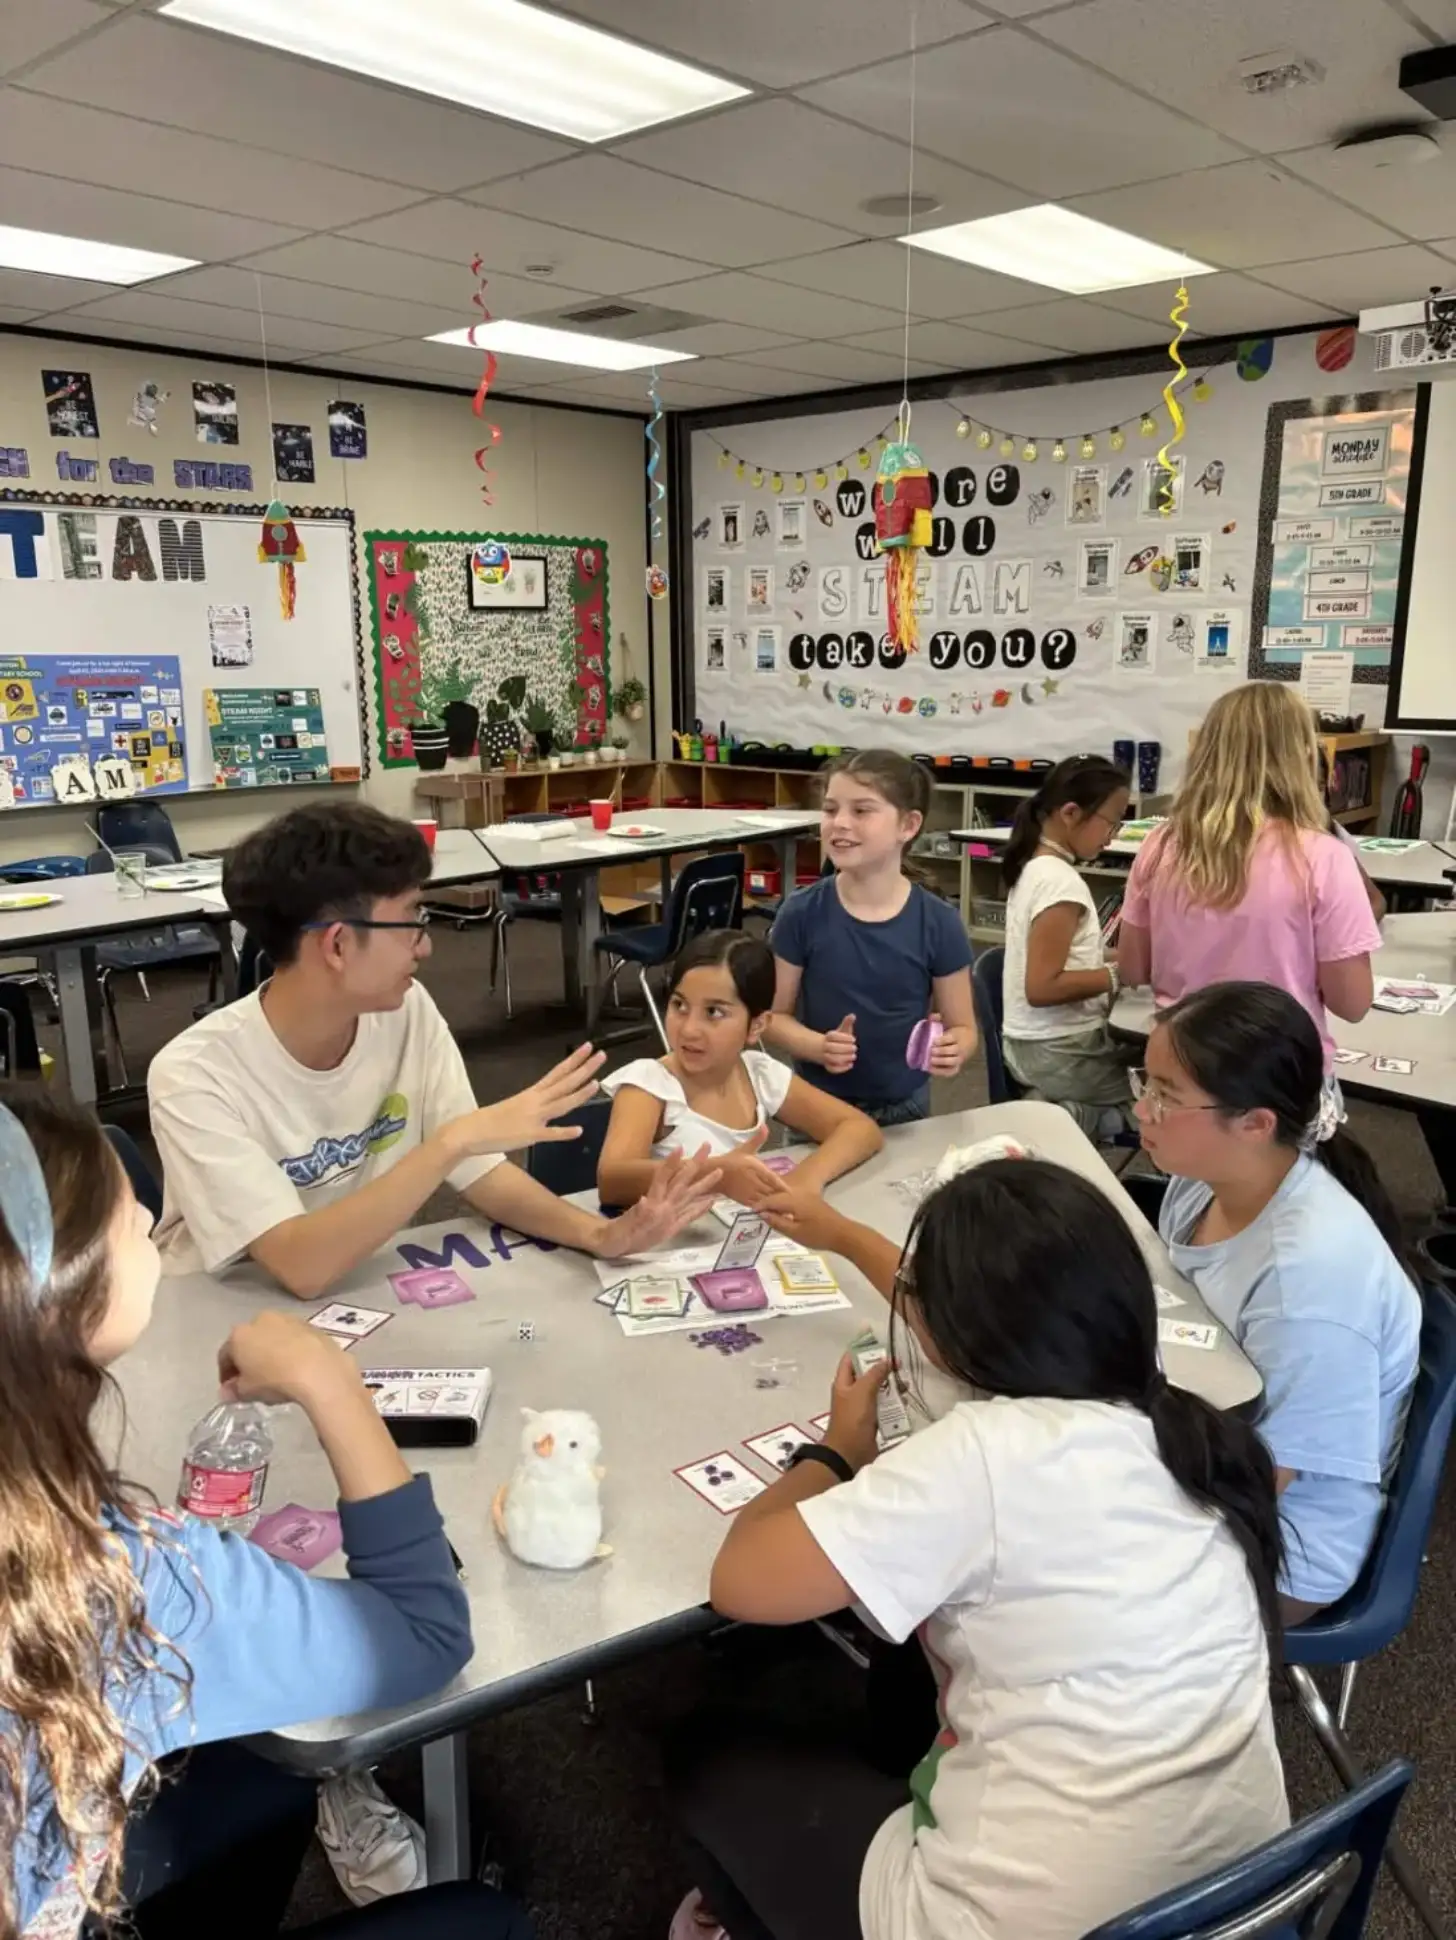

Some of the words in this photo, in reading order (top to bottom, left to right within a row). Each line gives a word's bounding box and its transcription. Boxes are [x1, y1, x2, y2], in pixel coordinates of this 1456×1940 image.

[1331, 438, 1380, 454] MONDAY
[56, 451, 99, 482] for
[109, 457, 154, 485] the
[173, 459, 253, 492] STARS
[838, 467, 1008, 516] wre
[1328, 490, 1344, 500] 5TH
[1345, 488, 1373, 499] GRADE
[0, 509, 206, 582] TEAM
[857, 518, 988, 558] wll
[820, 563, 1032, 617] STEAM
[1316, 603, 1331, 613] 4TH
[1332, 601, 1359, 613] GRADE
[799, 634, 896, 666] take
[932, 631, 1069, 666] you?
[418, 1371, 476, 1379] TACTICS
